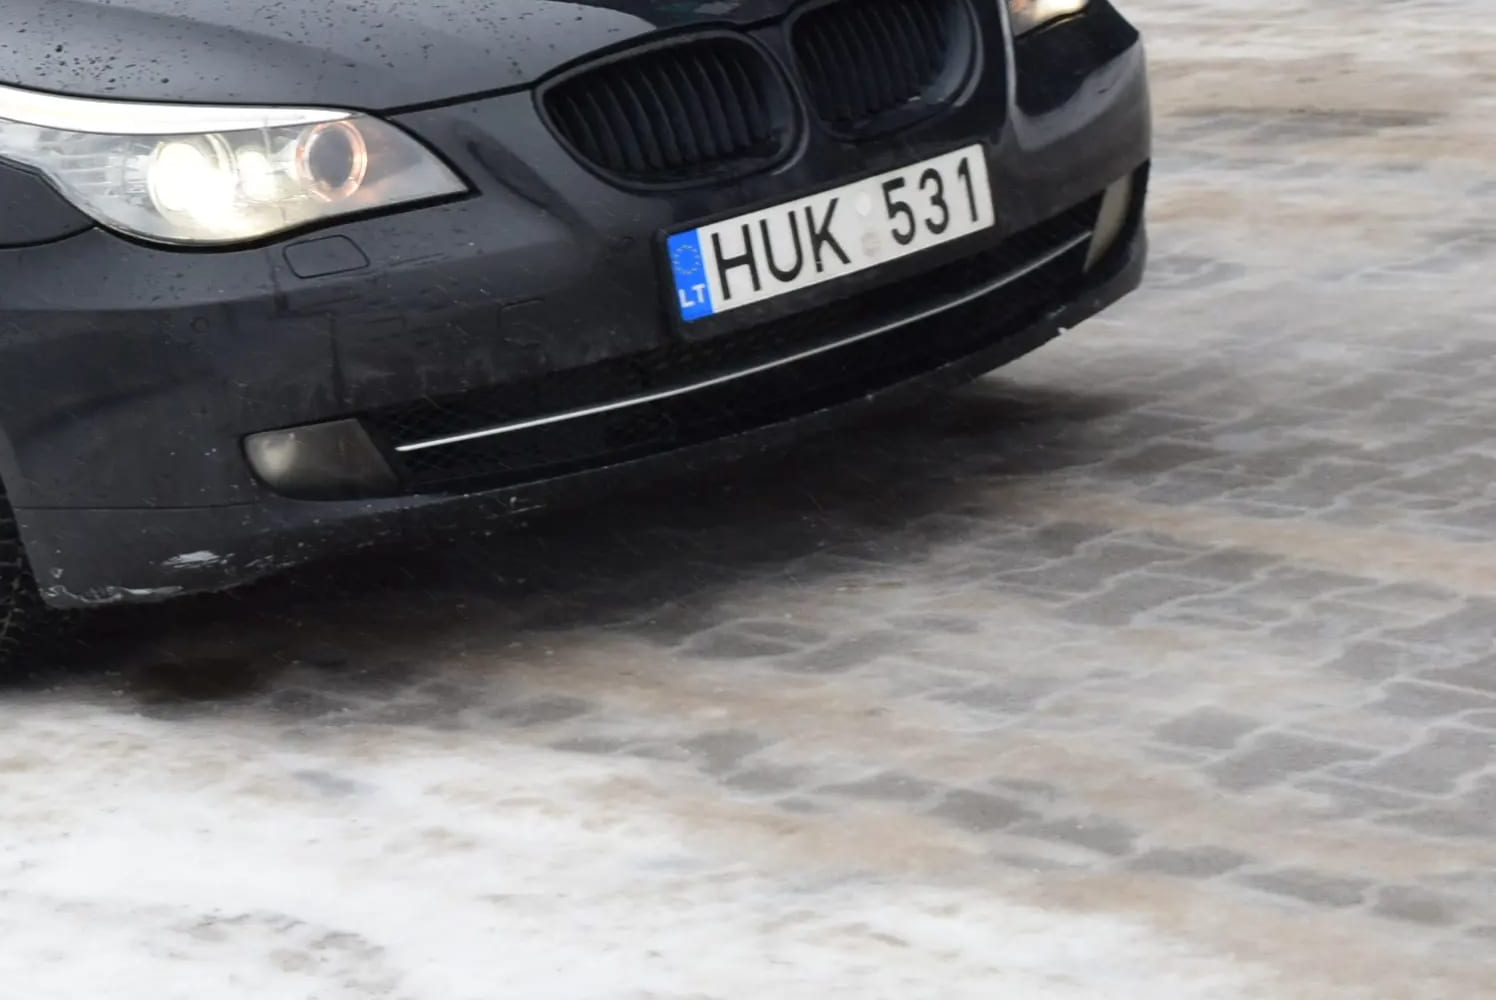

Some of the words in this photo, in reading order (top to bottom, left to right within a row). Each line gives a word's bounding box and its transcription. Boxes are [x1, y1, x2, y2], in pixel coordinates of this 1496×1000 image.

[711, 198, 851, 300] HUK
[881, 157, 980, 246] 531
[678, 283, 705, 308] LT
